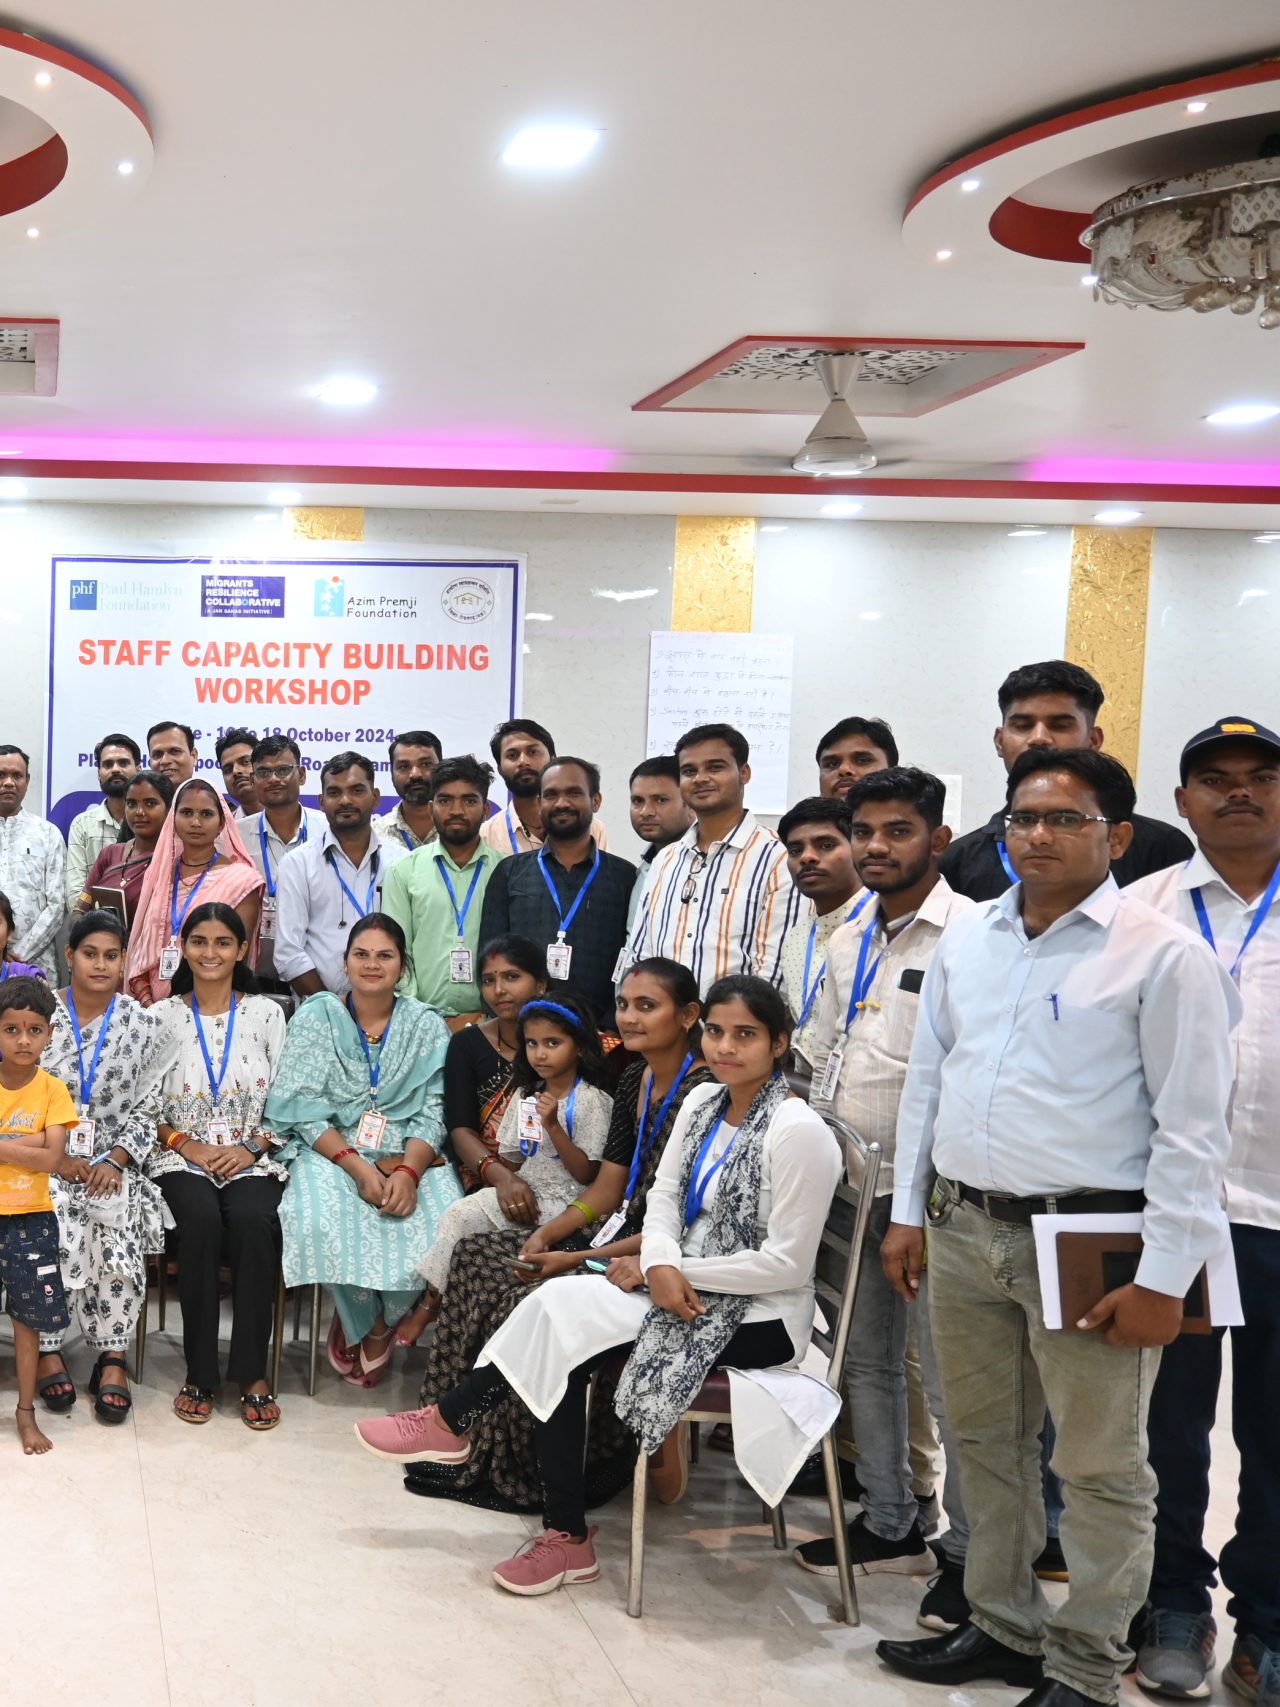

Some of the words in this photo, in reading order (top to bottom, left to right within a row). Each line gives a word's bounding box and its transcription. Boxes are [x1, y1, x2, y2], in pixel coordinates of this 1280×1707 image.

[72, 581, 95, 599] phf
[101, 582, 127, 596] Paul
[132, 582, 183, 597] Hamlyn
[206, 579, 253, 588] MIGRANTS
[206, 588, 259, 597] RESILIENCE
[100, 597, 171, 611] Foundation
[205, 598, 281, 607] COLLABORATIVE
[348, 597, 376, 606] Azim
[380, 597, 417, 609] Premji
[347, 608, 417, 618] Foundation
[79, 639, 171, 666] STAFF
[182, 641, 332, 669] CAPACITY
[344, 643, 489, 671] BUILDING
[195, 678, 372, 706] WORKSHOP
[287, 727, 351, 742] October
[355, 728, 397, 742] 2024
